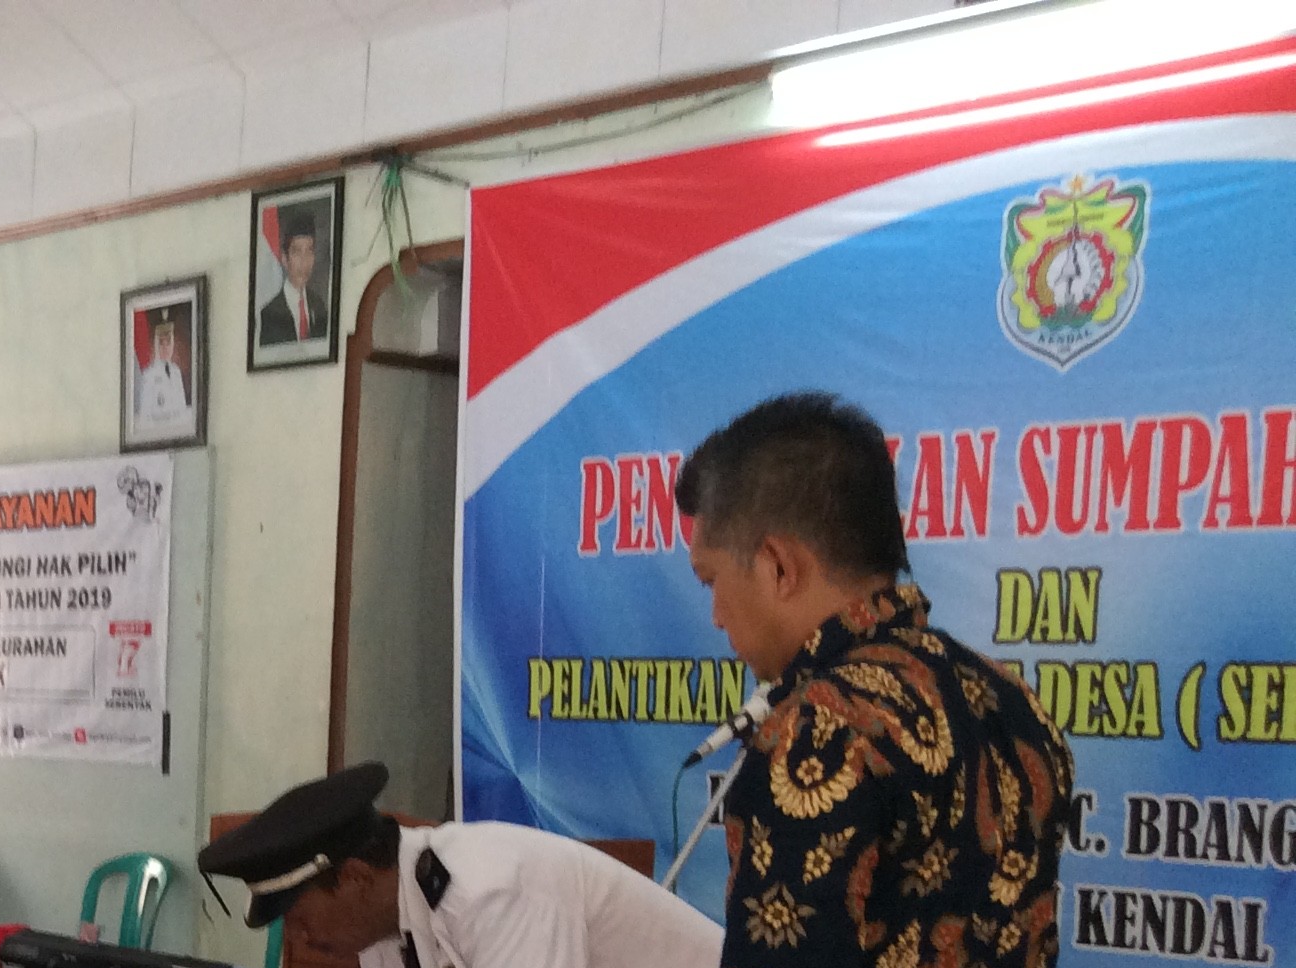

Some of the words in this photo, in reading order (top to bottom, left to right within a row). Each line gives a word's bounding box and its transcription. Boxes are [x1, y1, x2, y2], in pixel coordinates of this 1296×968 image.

[1017, 410, 1296, 537] SUMPAH
[6, 587, 62, 611] TAHUN
[67, 586, 112, 611] 2019
[36, 554, 72, 578] HAK
[993, 566, 1101, 643] DAN
[528, 657, 746, 725] PELANTIKAN
[1035, 660, 1164, 738] DESA
[1125, 796, 1296, 868] BRANG
[1076, 888, 1270, 963] KENDAL
